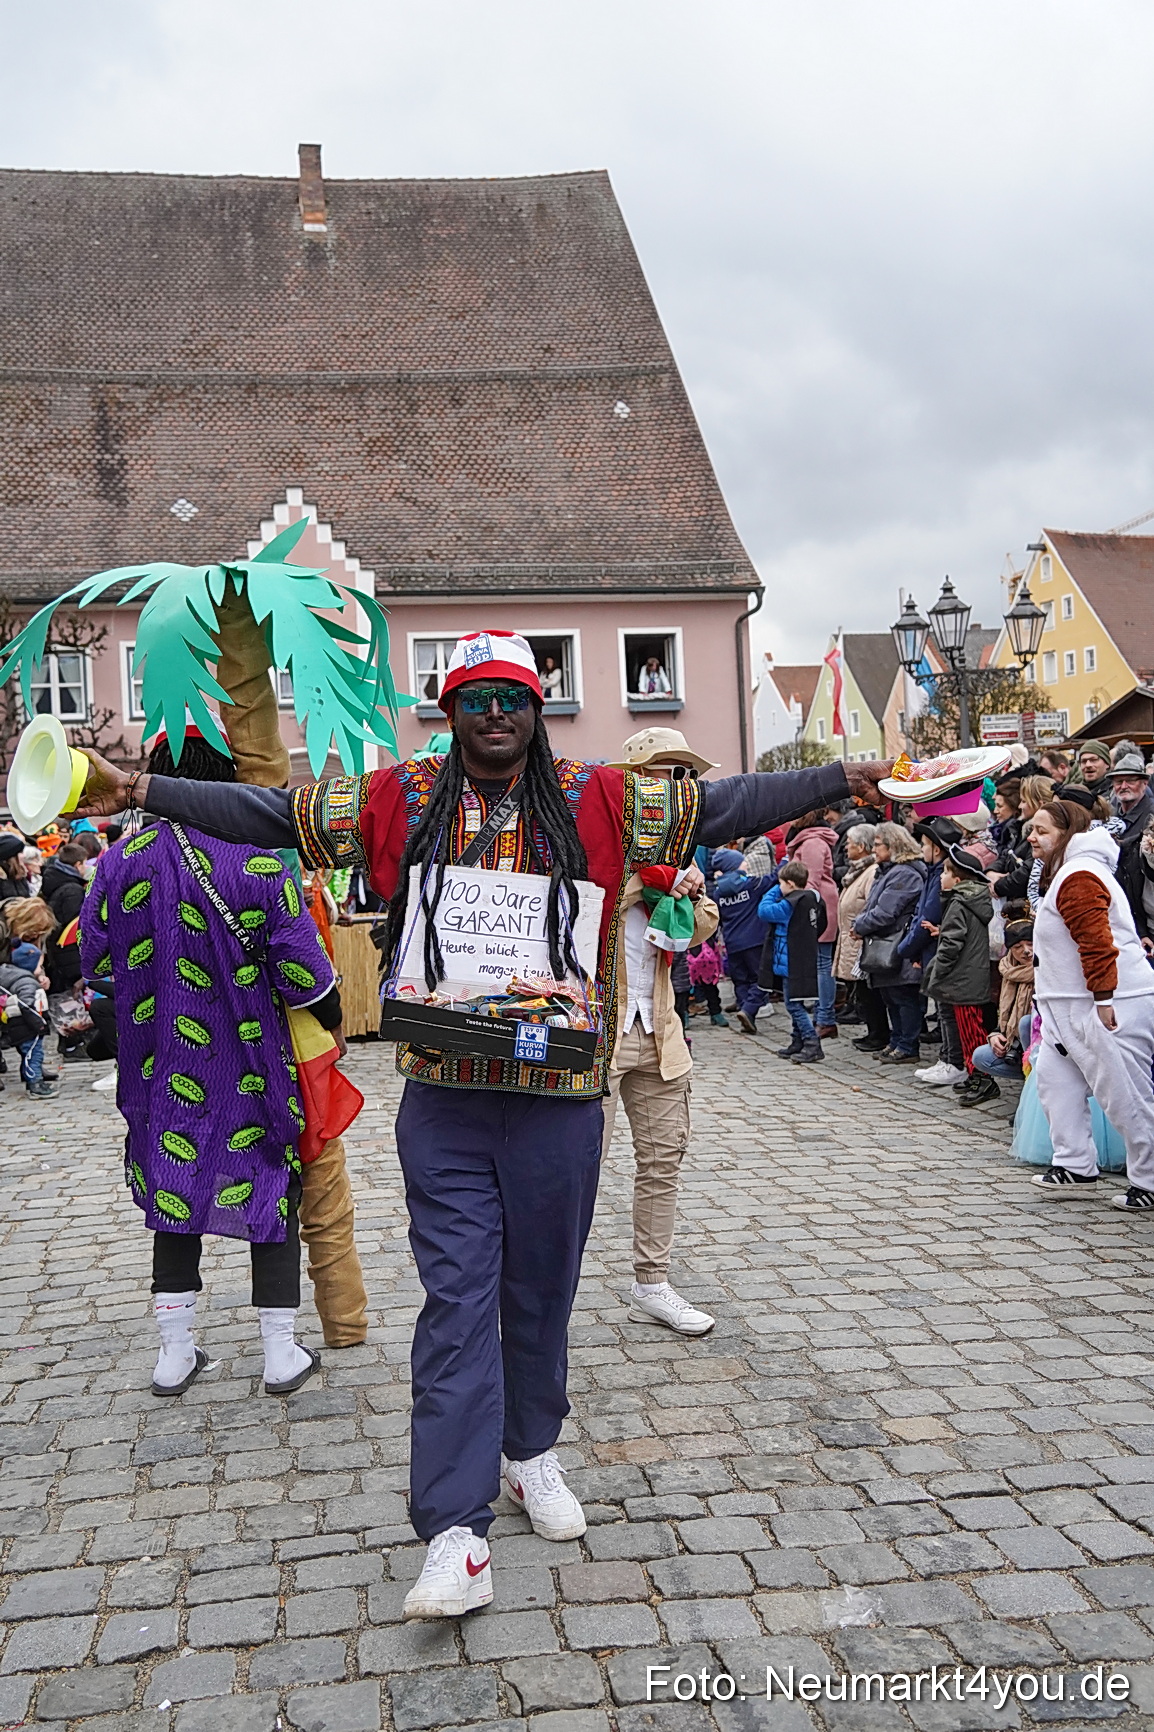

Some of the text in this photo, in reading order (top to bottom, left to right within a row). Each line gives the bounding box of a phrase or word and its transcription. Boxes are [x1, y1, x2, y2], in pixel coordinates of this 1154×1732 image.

[183, 846, 201, 871] MAKE
[195, 869, 204, 879] A
[199, 876, 229, 915] CHANGE
[441, 878, 542, 912] 100 Jare
[719, 890, 750, 907] POLIZEI
[439, 939, 476, 954] Heute
[485, 942, 519, 958] bilick
[465, 1018, 482, 1026] Taste
[517, 1047, 543, 1058] SÜD
[518, 1041, 544, 1050] KURVA
